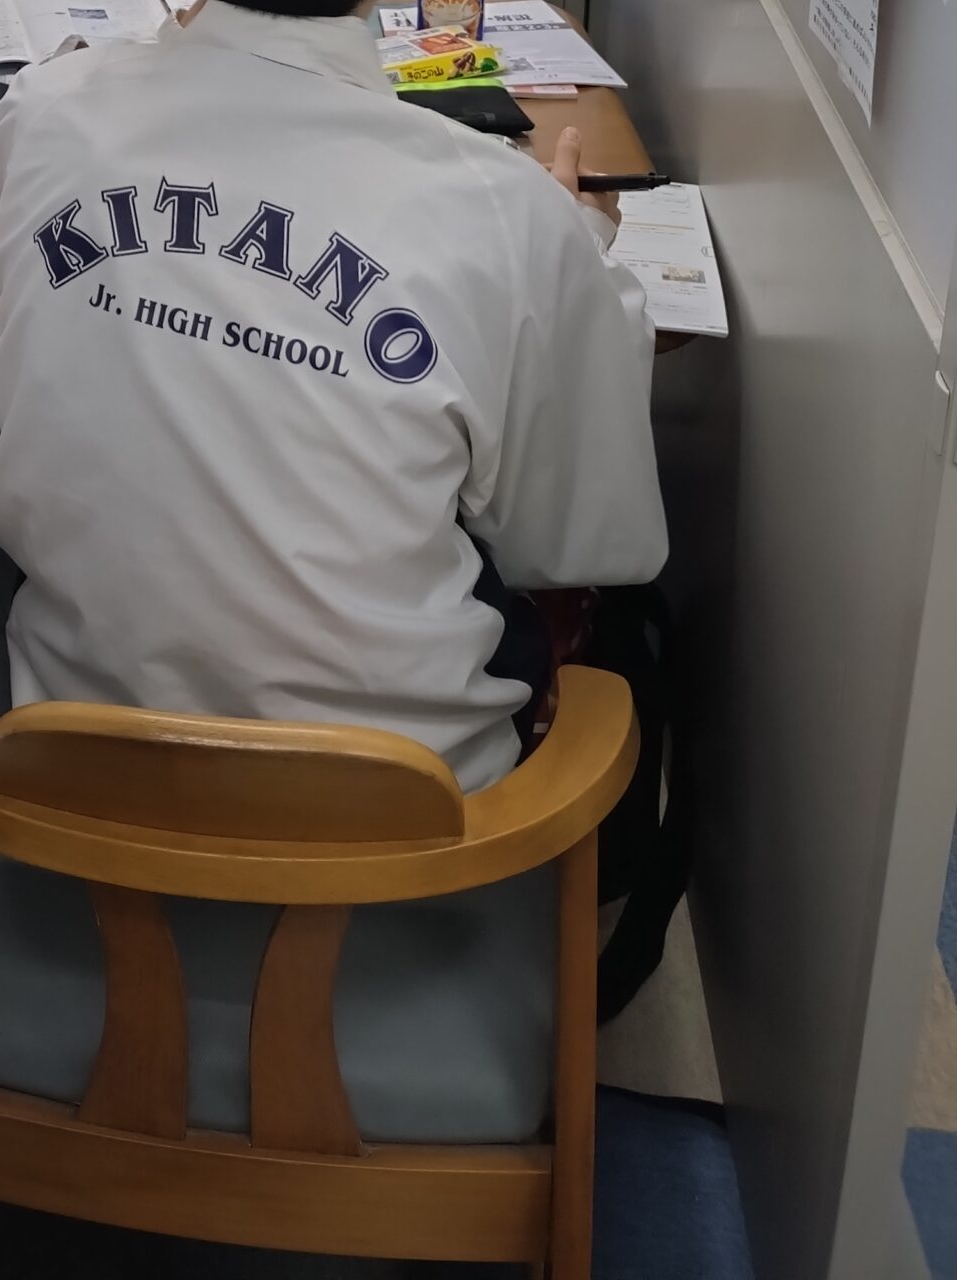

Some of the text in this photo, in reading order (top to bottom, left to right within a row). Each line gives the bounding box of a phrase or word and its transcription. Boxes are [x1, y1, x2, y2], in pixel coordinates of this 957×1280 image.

[34, 175, 439, 384] KITANO
[89, 284, 350, 378] Jr. HIGH SCHOOL
